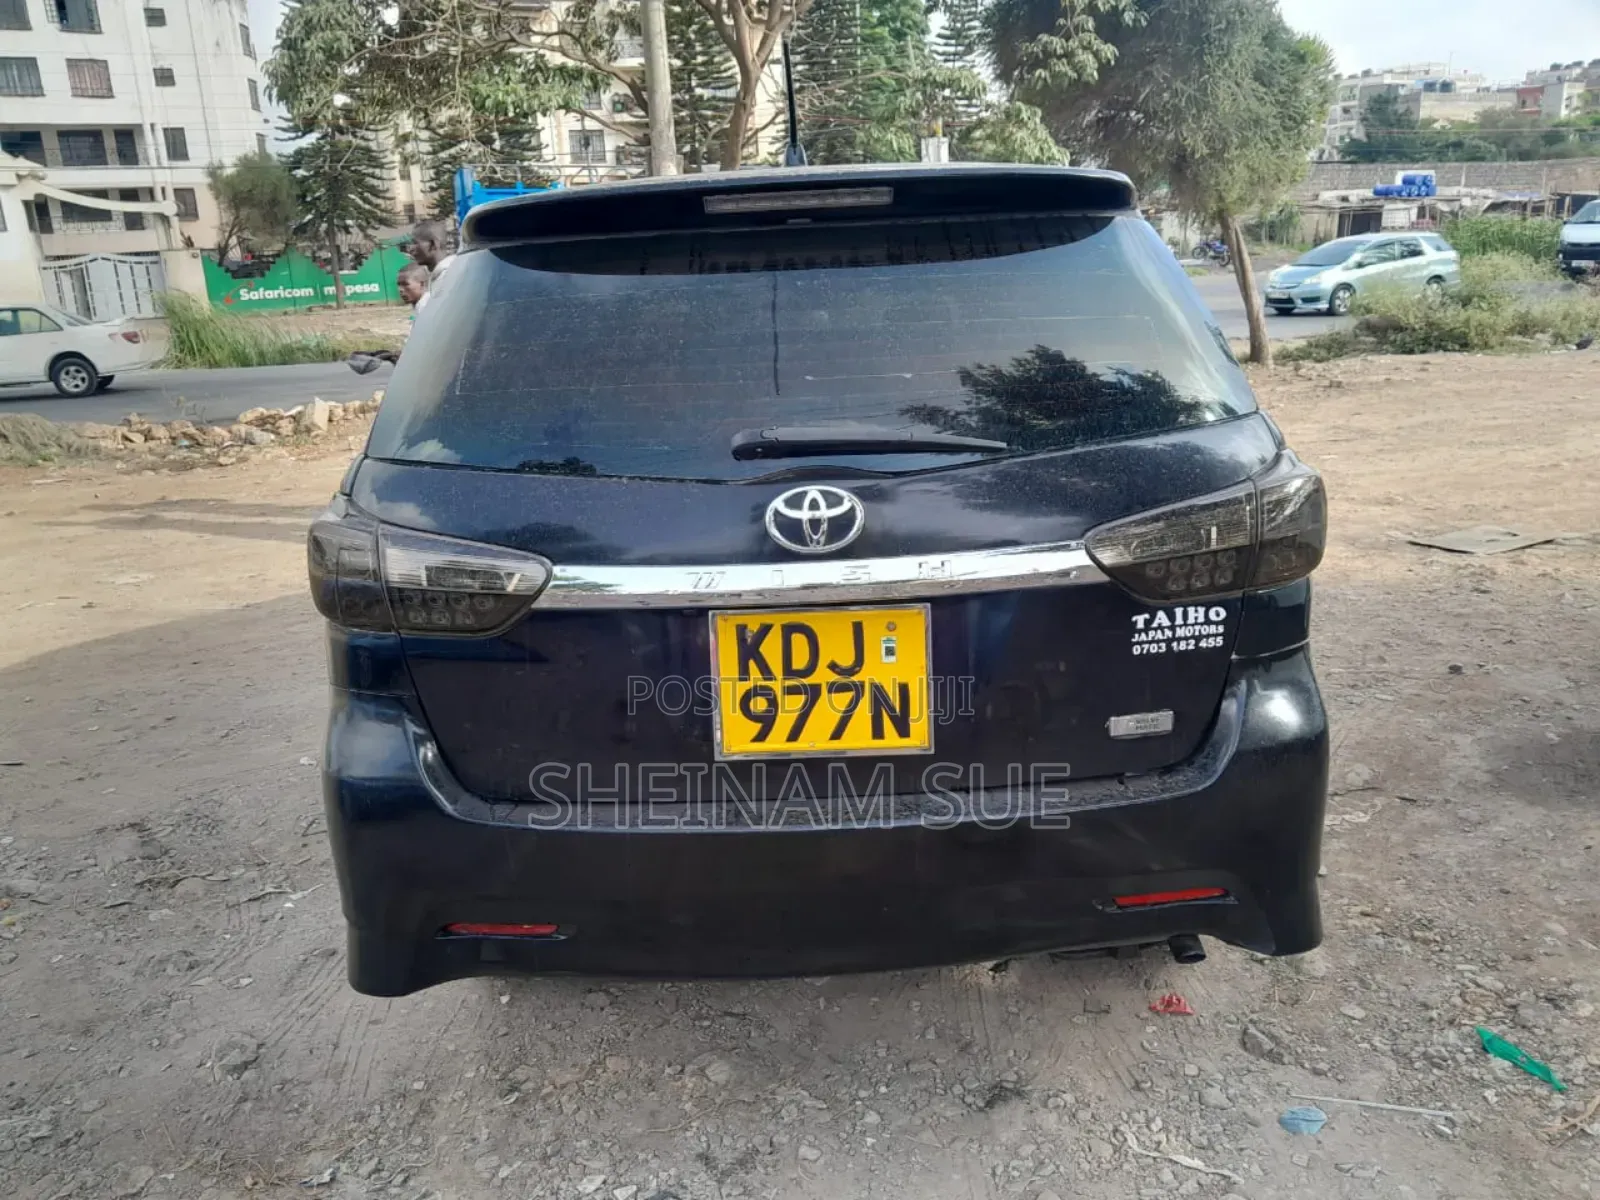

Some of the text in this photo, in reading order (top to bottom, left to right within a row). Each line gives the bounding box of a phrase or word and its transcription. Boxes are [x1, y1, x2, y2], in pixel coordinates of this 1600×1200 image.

[239, 286, 314, 301] Safaricom
[1131, 606, 1227, 629] TAIHO
[1131, 624, 1225, 642] JAPAN MOTORS
[735, 620, 865, 682] KDJ
[1132, 636, 1224, 655] 0703 182 455
[739, 681, 911, 743] 977N
